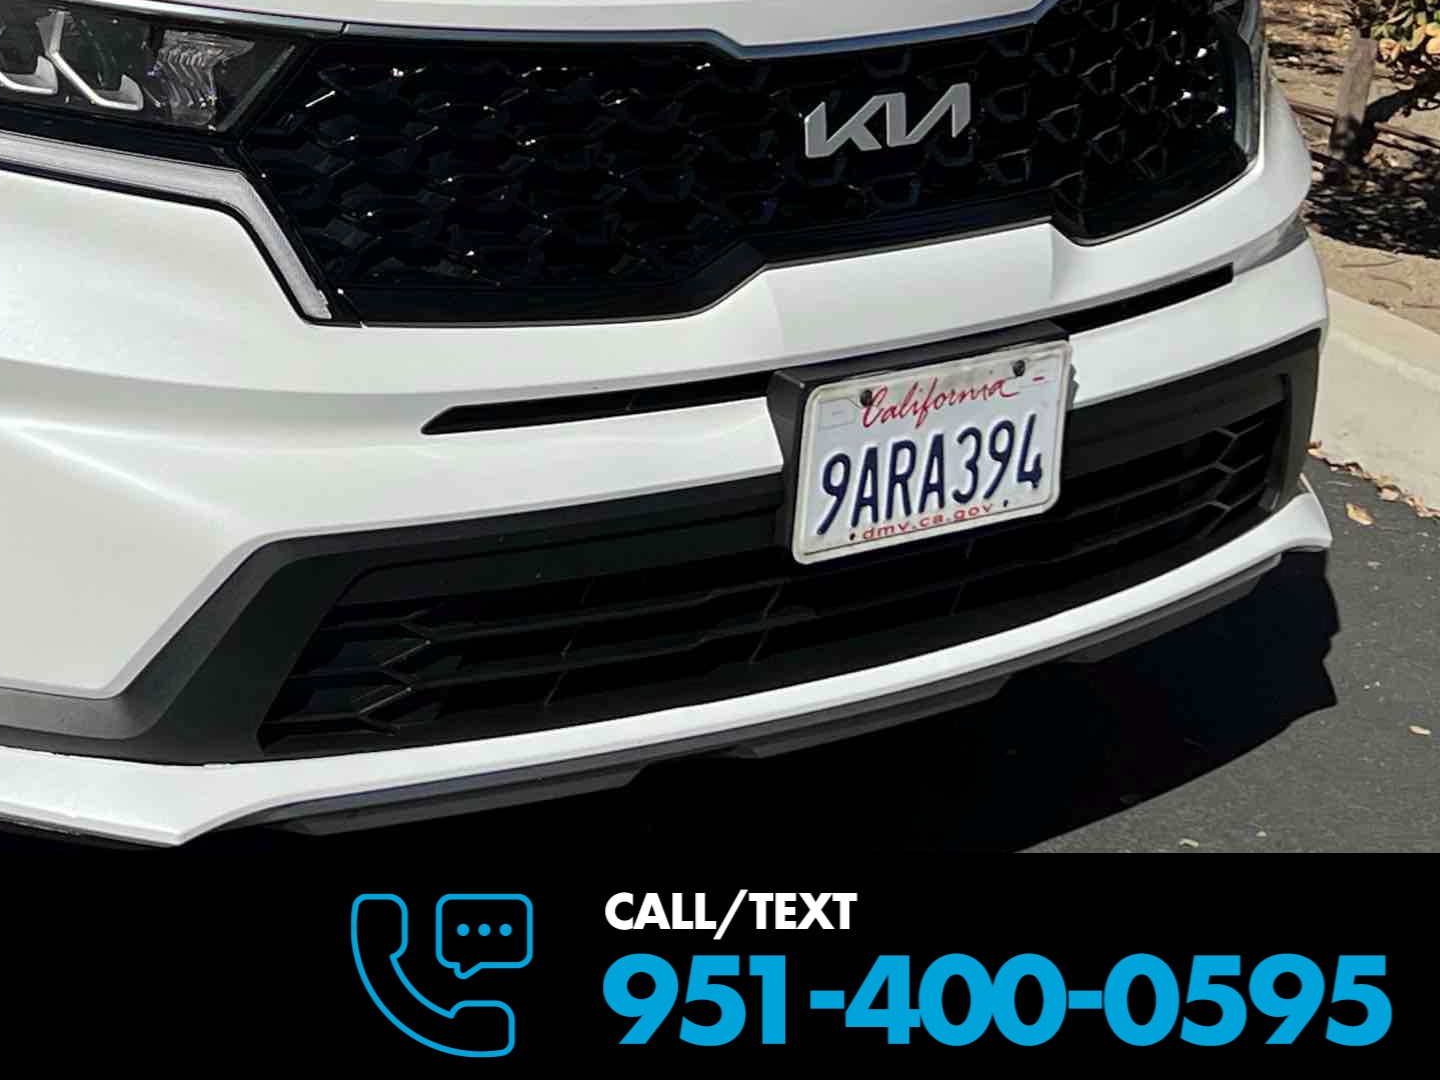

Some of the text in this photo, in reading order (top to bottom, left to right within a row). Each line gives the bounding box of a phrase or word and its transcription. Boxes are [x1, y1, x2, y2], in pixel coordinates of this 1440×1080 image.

[862, 376, 1020, 429] California
[816, 413, 1043, 536] 9ARA394
[862, 502, 995, 540] dmv.ca.gov
